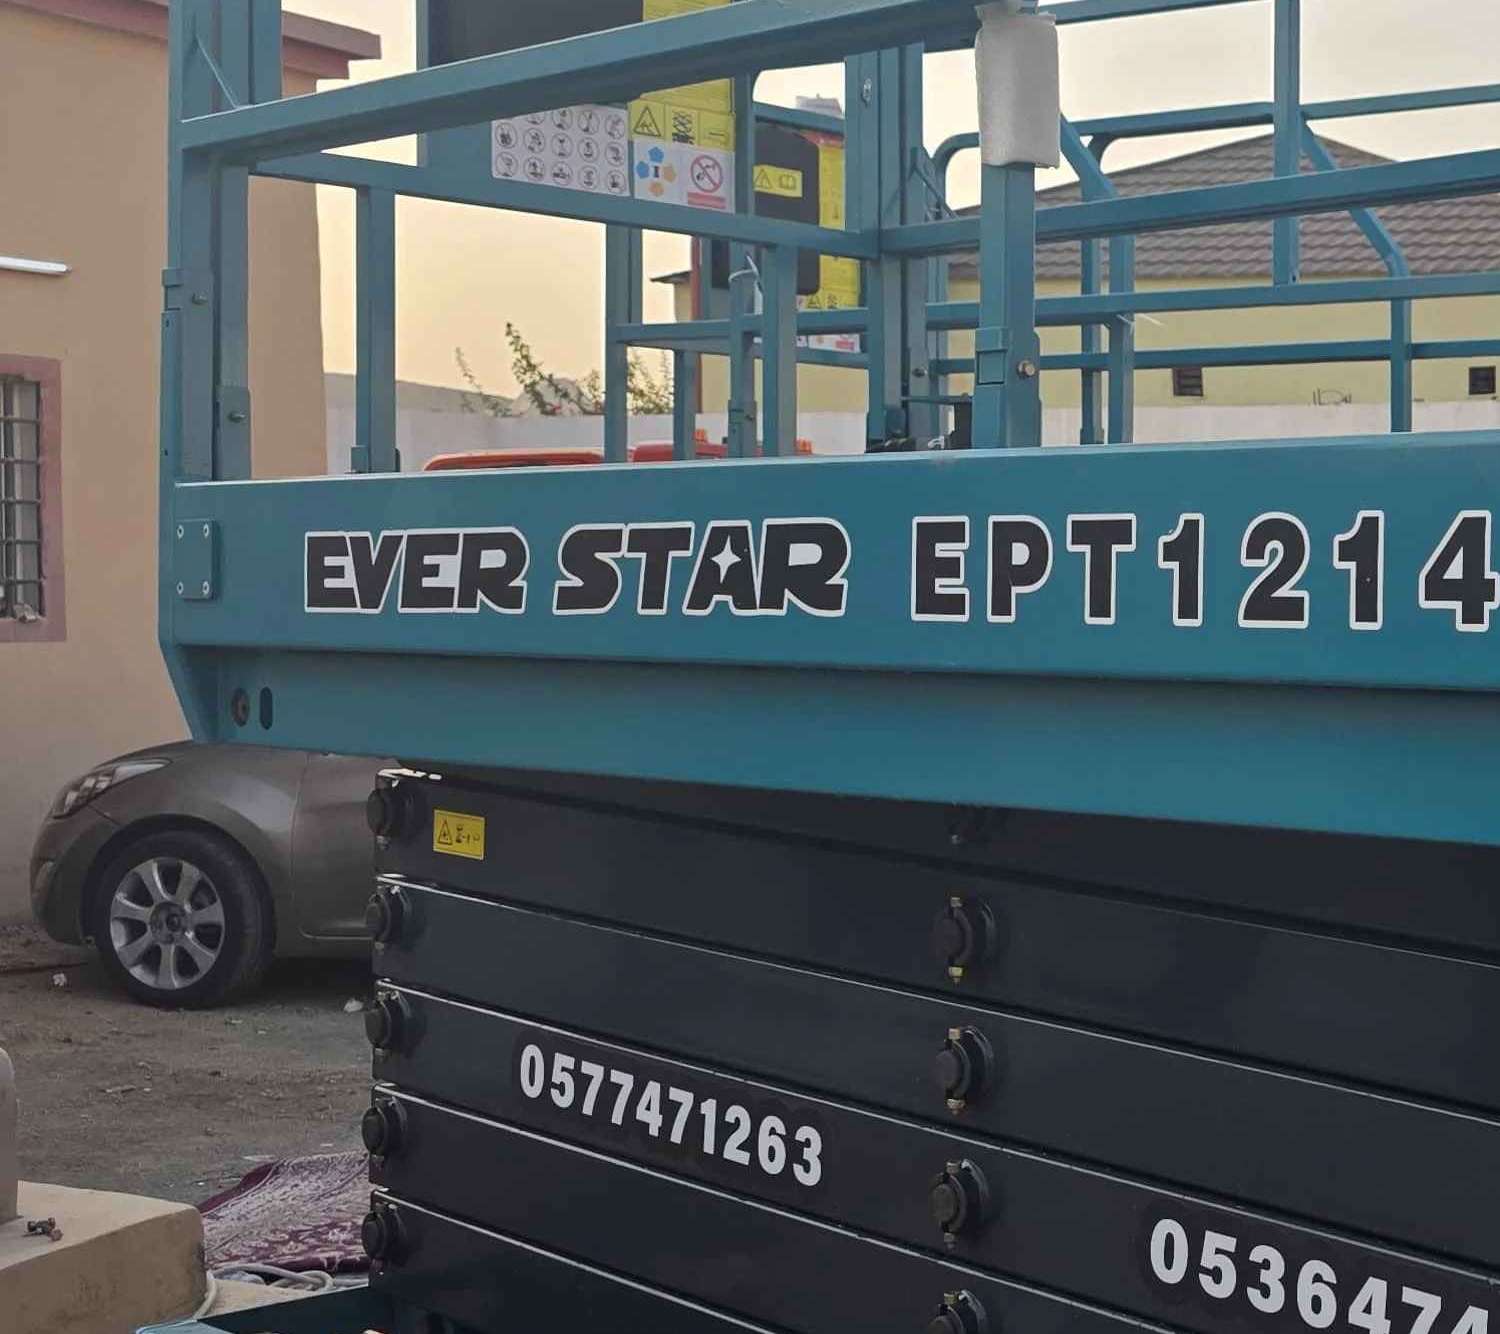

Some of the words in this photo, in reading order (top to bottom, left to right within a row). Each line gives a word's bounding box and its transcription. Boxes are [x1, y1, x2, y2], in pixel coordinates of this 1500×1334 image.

[304, 526, 530, 615] EVER
[553, 517, 852, 617] STAR
[911, 510, 1500, 633] EPT1214
[520, 1044, 823, 1187] 0577471263
